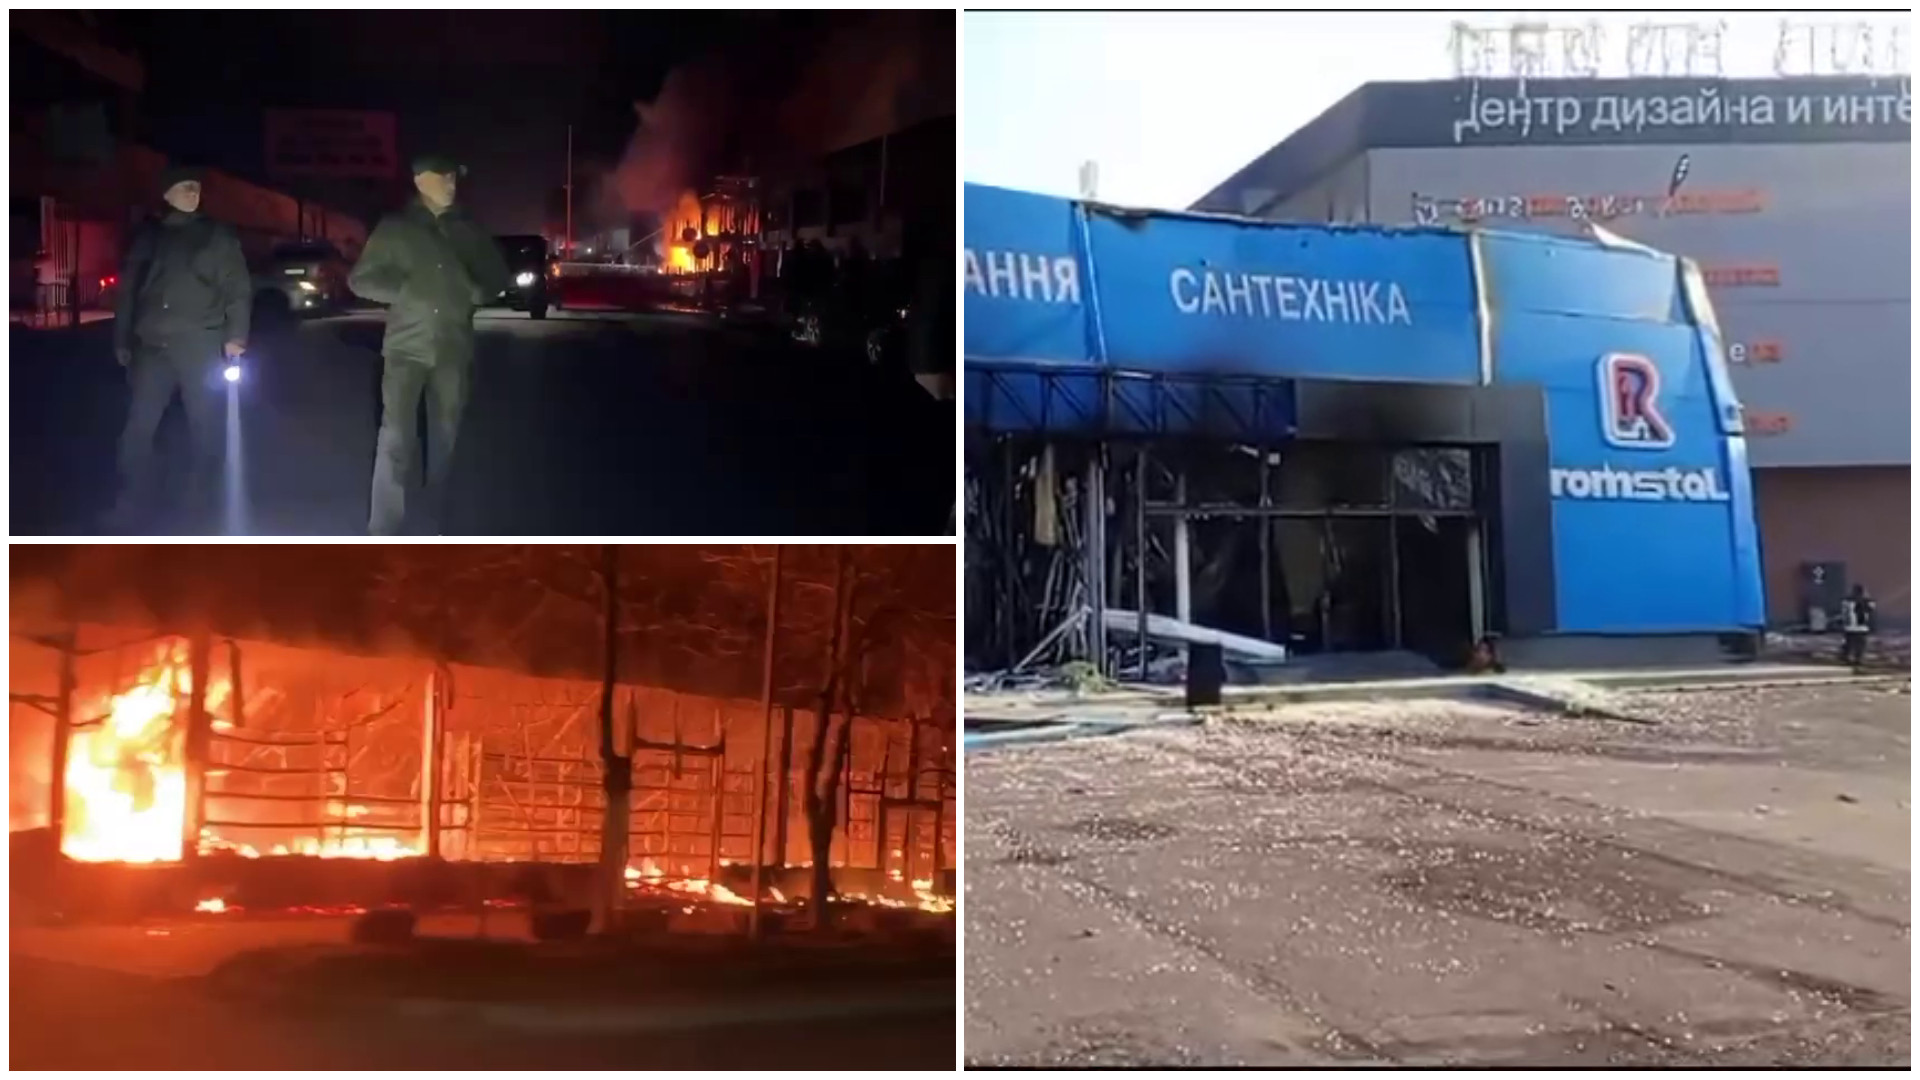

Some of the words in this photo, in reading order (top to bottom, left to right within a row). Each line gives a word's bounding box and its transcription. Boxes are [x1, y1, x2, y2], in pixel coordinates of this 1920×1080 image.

[1590, 88, 1776, 133] дизайна
[1786, 96, 1812, 125] и
[1169, 267, 1412, 327] САНТЕХНІКА
